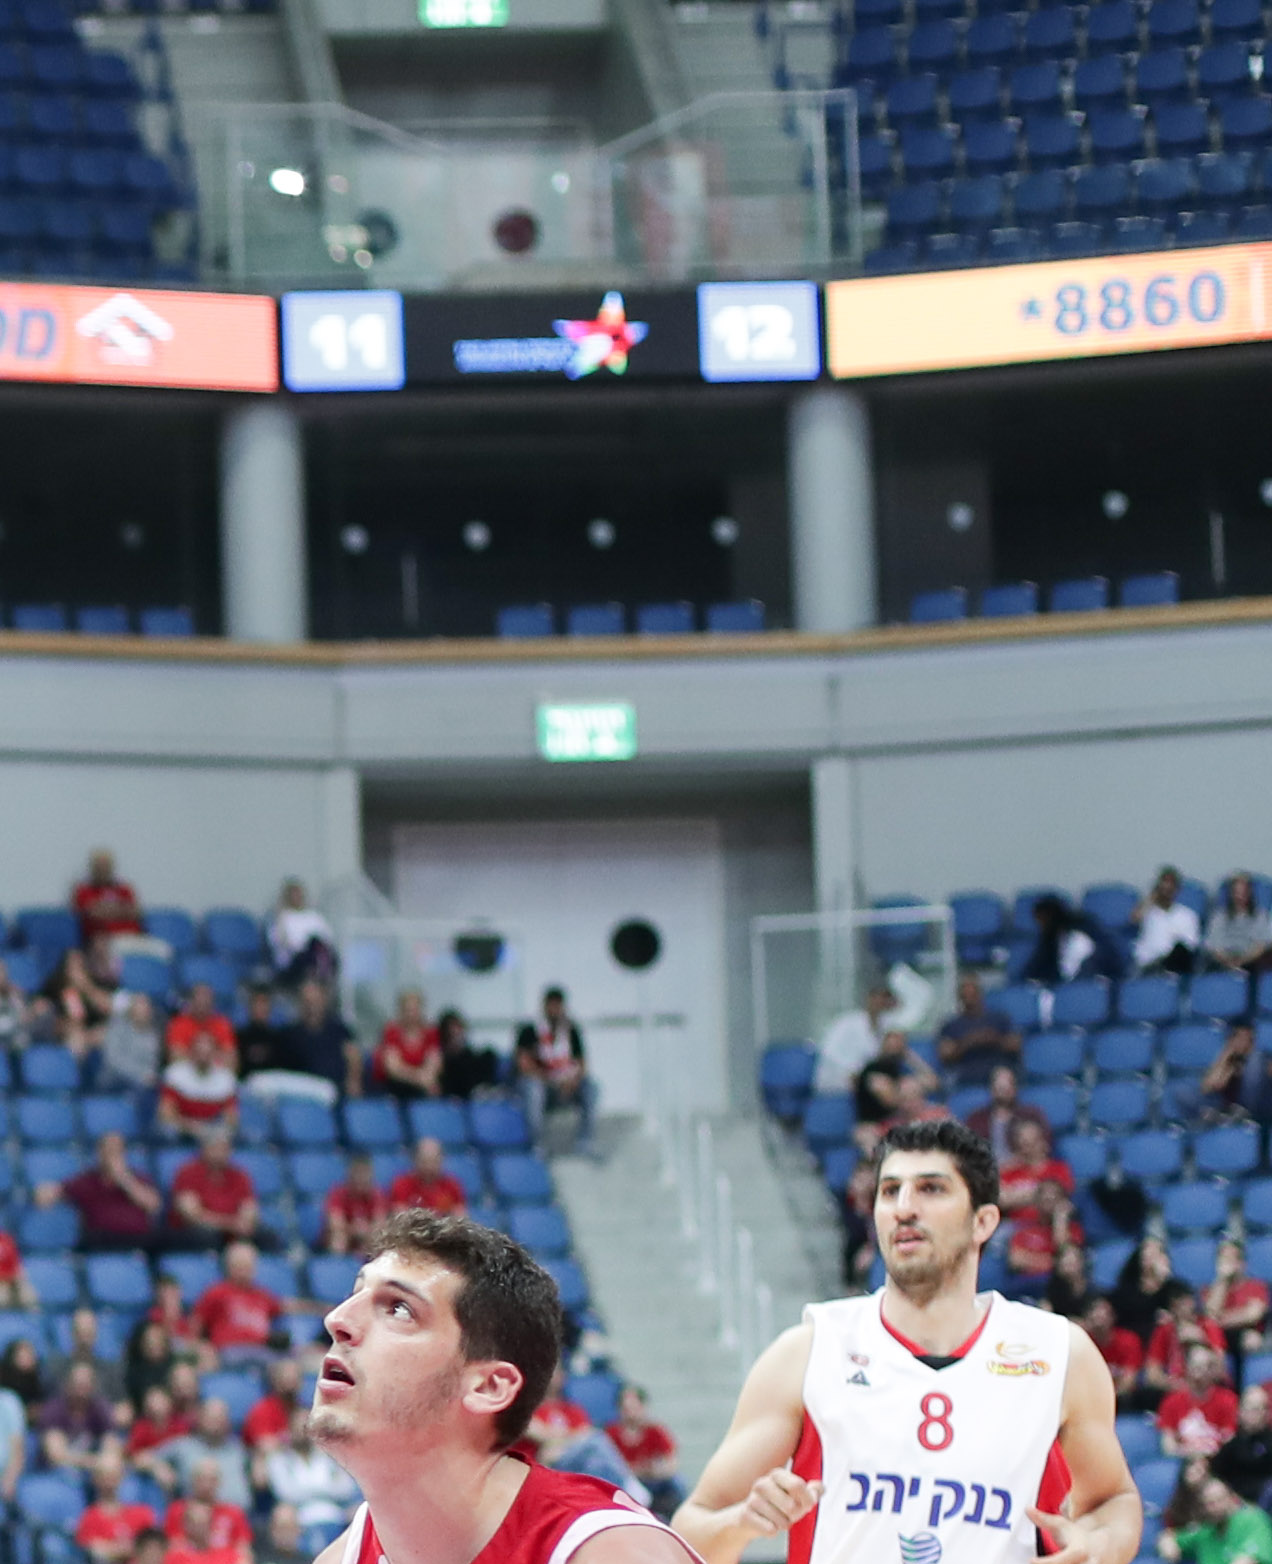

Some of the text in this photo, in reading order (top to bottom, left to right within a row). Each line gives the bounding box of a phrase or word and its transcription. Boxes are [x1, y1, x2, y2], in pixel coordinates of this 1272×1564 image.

[309, 313, 387, 371] 11
[711, 303, 798, 363] 12
[917, 1391, 954, 1451] 8
[846, 1471, 1013, 1531] בנק יהב
